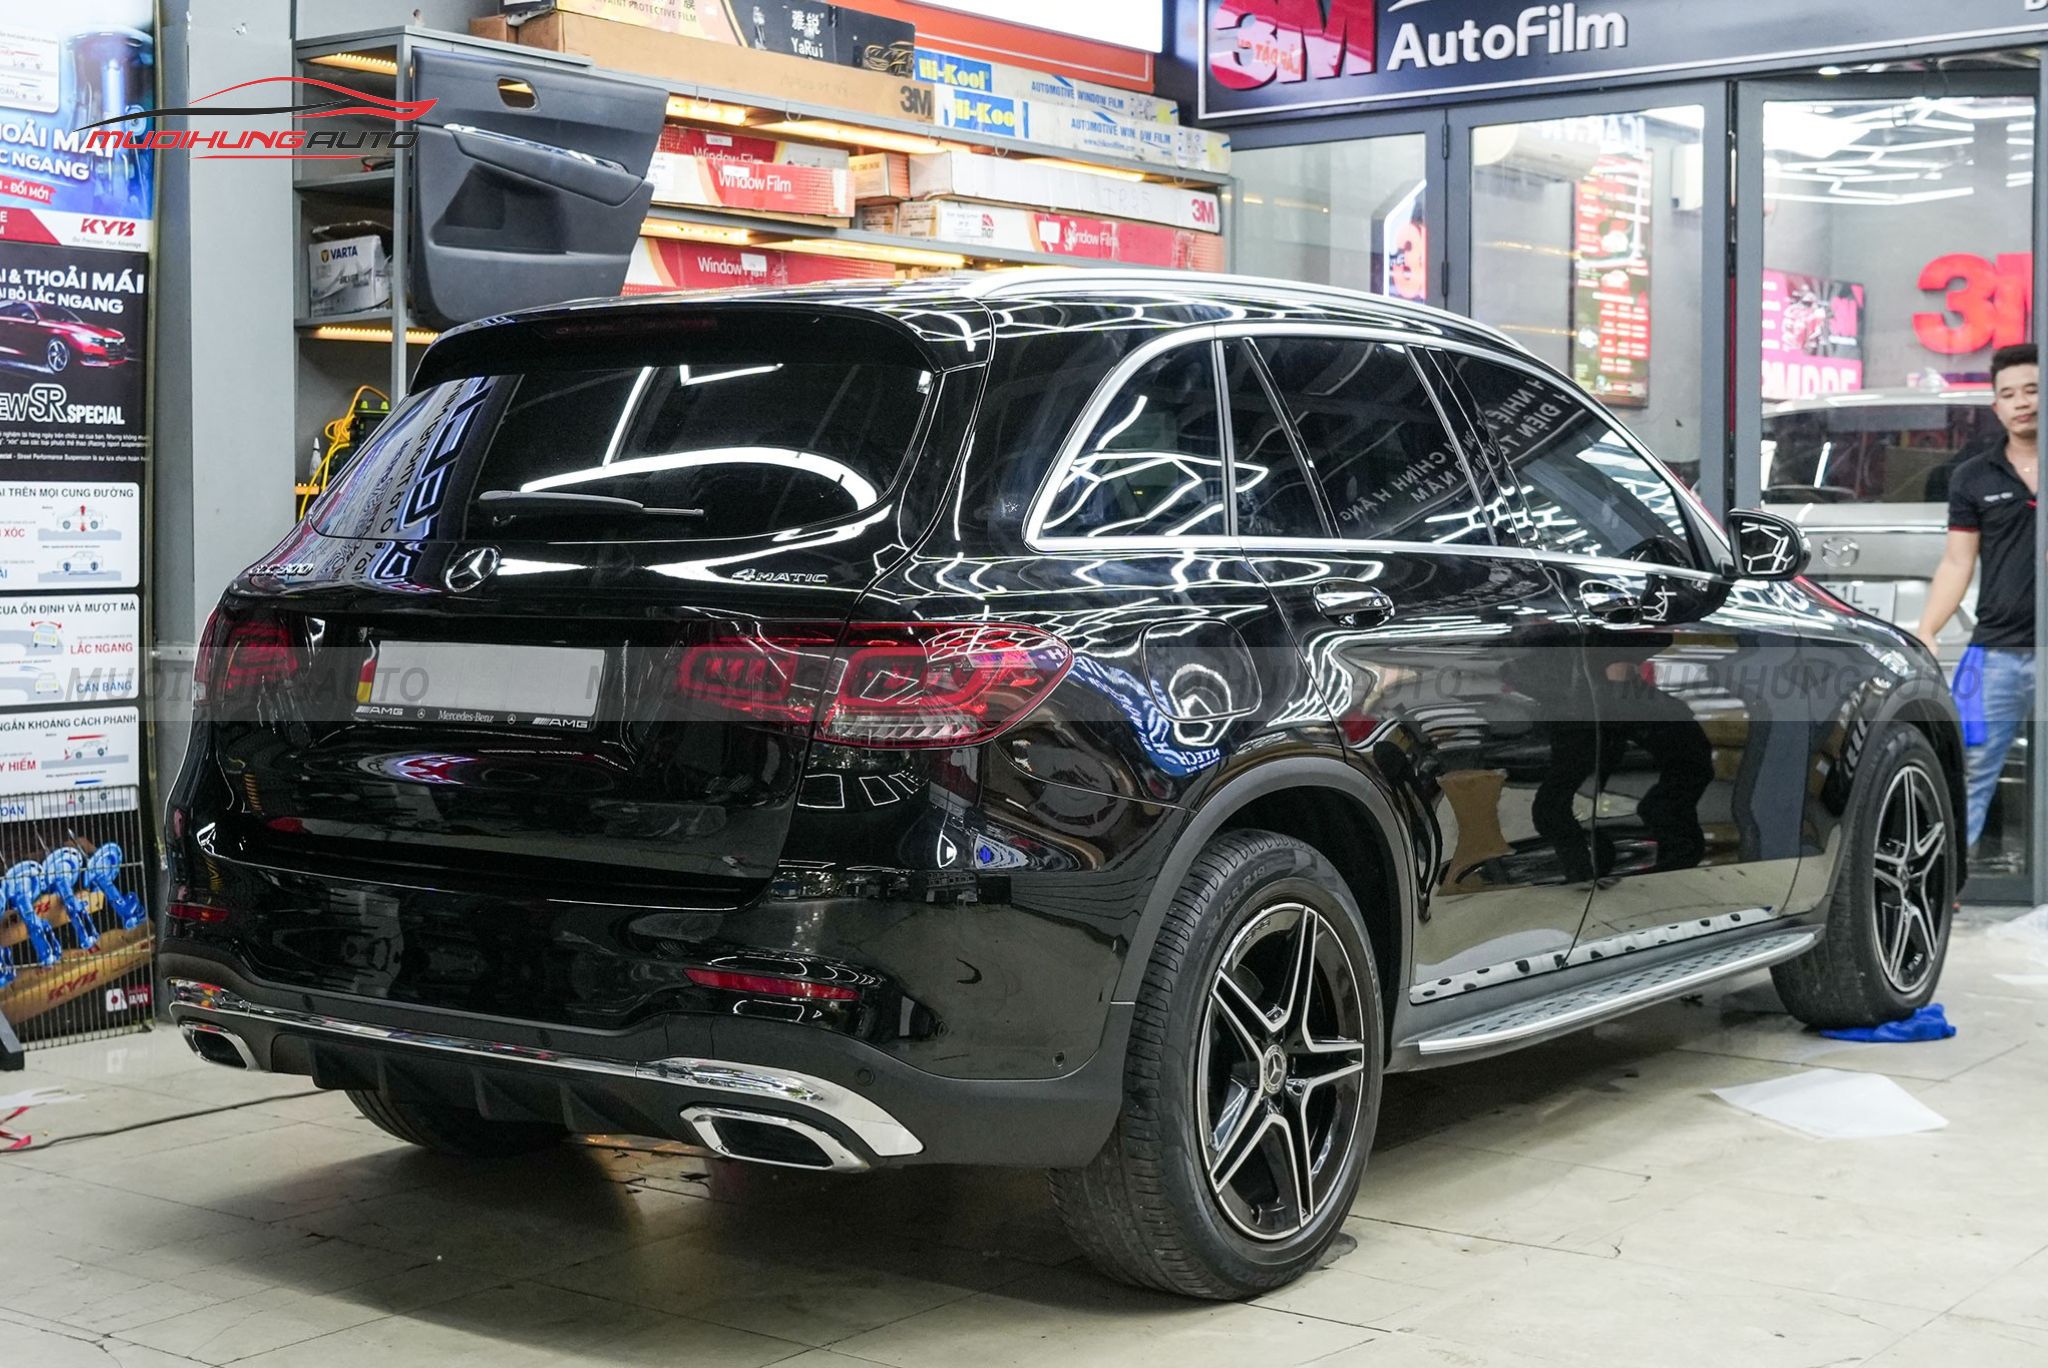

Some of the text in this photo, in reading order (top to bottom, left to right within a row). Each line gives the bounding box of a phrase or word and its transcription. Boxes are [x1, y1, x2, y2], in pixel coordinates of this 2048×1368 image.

[628, 1, 676, 18] PROTECTIVE
[678, 11, 697, 23] FILM
[791, 37, 823, 58] YaRui
[1210, 0, 1628, 89] 3M AutoFilm
[920, 58, 986, 90] Hi-Kool
[900, 85, 932, 117] 3M
[1031, 81, 1124, 109] AUTOMOTIVE WINDOW FILM
[0, 118, 47, 148] OẢI
[1071, 118, 1118, 136] AUTOMOTIVE
[1154, 133, 1171, 145] FILM
[12, 150, 90, 181] NGANG
[766, 175, 791, 192] Film
[1191, 198, 1215, 224] 3M
[80, 217, 136, 237] KYB
[330, 245, 358, 260] VARTA
[698, 256, 742, 275] Window
[24, 265, 87, 290] THOẢI
[92, 268, 145, 295] MÁI
[58, 294, 123, 314] NGANG
[0, 393, 31, 421] EW
[67, 405, 125, 425] SPECIAL
[9, 486, 36, 498] TRÊN
[39, 487, 59, 501] MỌI
[61, 487, 91, 498] CUNG
[93, 486, 134, 498] ĐƯỜNG
[4, 526, 25, 538] XÓC
[731, 568, 829, 584] 4MATIC
[39, 602, 65, 616] ĐỊNH
[67, 601, 82, 613] VÀ
[85, 602, 117, 614] MƯỢT
[121, 600, 136, 611] MÀ
[95, 642, 133, 654] NGANG
[369, 706, 404, 716] AMG
[438, 710, 495, 723] Mercedes-Benz
[28, 716, 71, 730] KHOẢNG
[74, 714, 101, 727] CÁCH
[104, 713, 137, 725] PHANH
[550, 719, 589, 729] AMG
